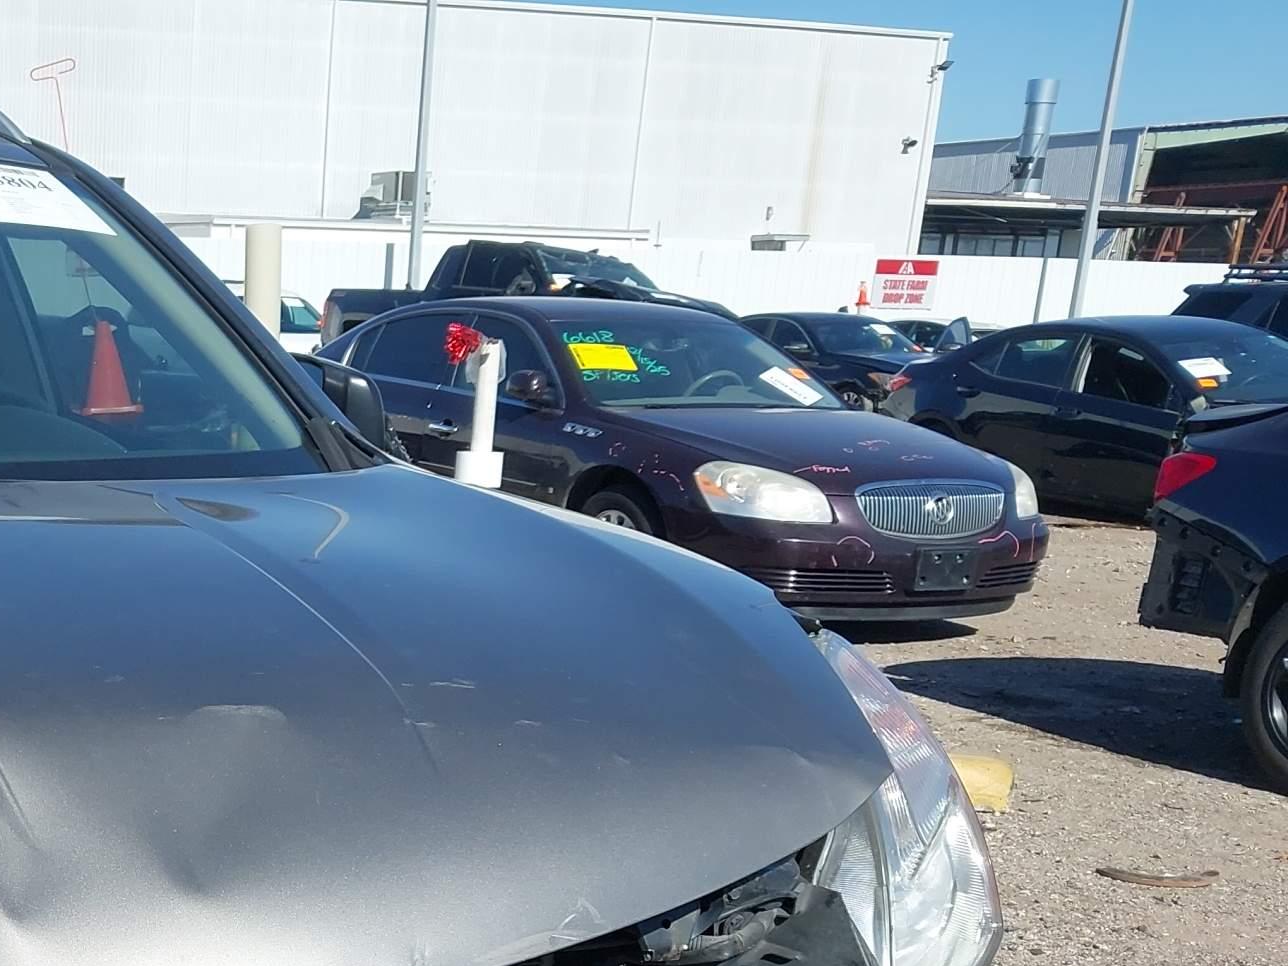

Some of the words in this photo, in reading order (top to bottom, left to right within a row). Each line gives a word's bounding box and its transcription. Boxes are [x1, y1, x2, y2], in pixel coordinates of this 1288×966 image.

[883, 279, 906, 290] STATE
[906, 279, 928, 291] FARM
[882, 292, 904, 303] DROP
[904, 293, 924, 304] ZONE
